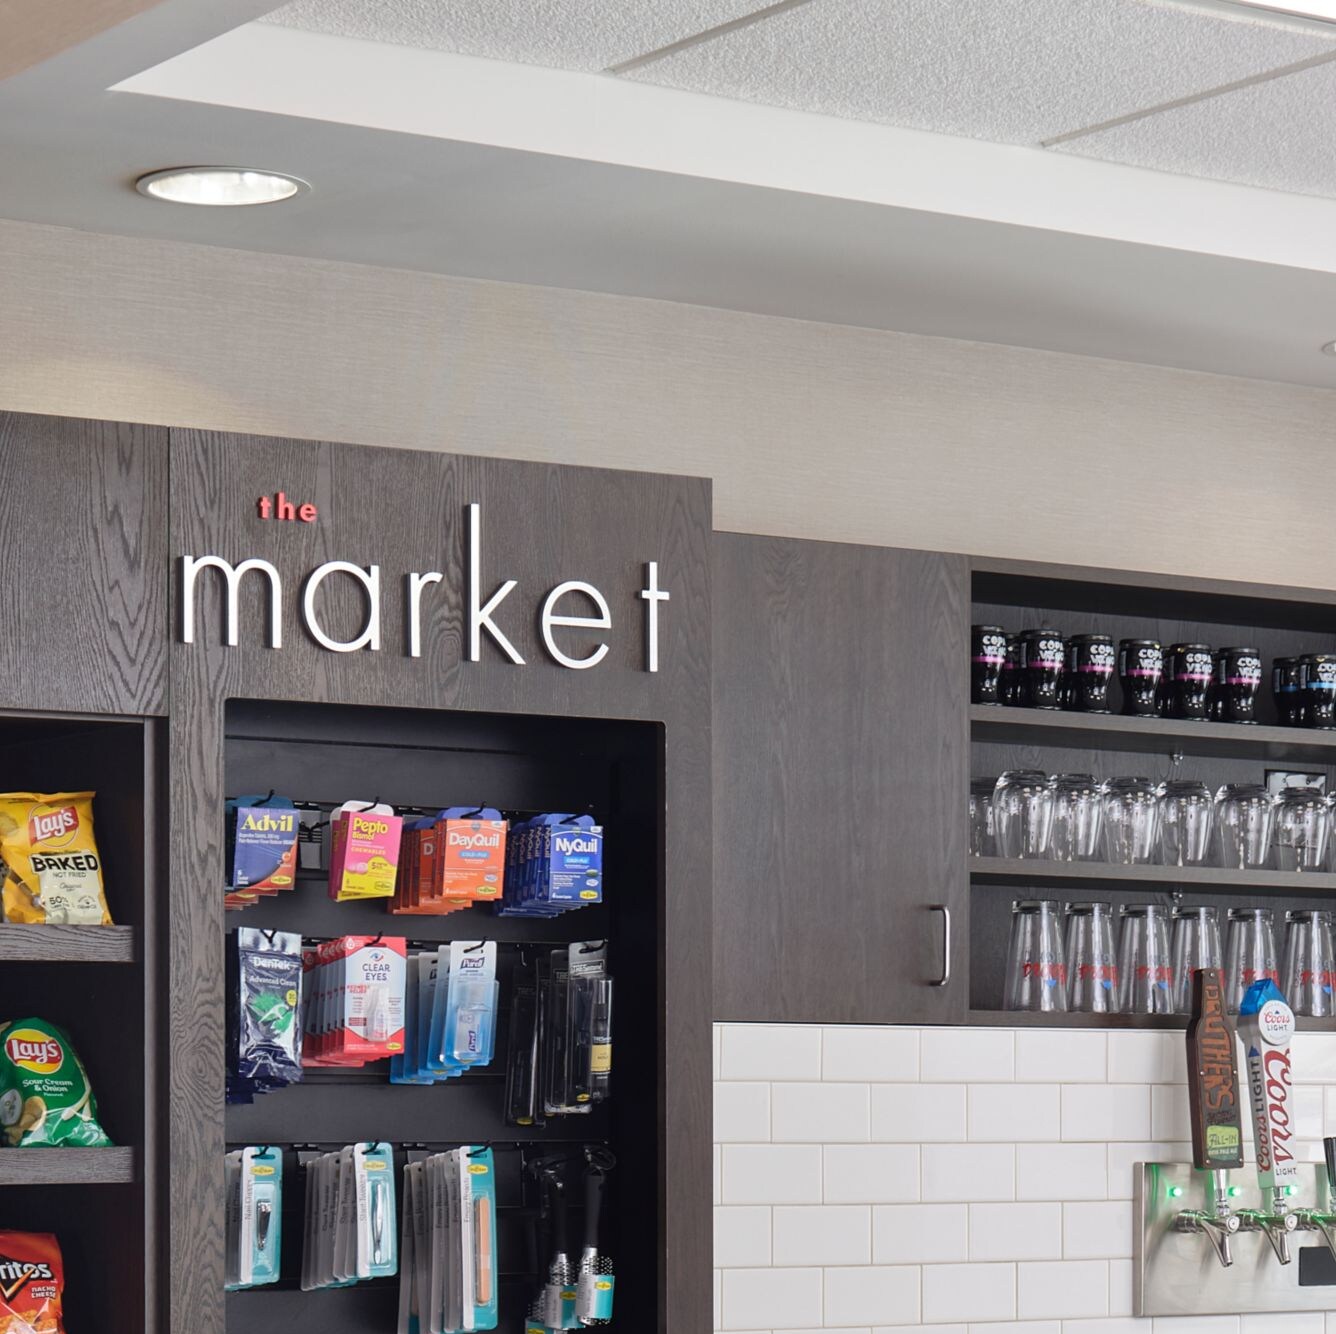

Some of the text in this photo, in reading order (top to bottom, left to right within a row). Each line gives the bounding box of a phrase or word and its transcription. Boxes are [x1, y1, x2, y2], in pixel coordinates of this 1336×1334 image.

[257, 491, 318, 522] the
[178, 503, 670, 673] market
[33, 810, 74, 841] Lay's
[241, 814, 293, 832] Advil
[353, 817, 389, 834] Pepto
[352, 831, 375, 840] Bismol
[449, 832, 500, 849] DayQuil
[556, 838, 598, 855] NyQuil
[31, 855, 99, 872] BAKED
[253, 956, 291, 970] DenTek
[362, 964, 391, 972] CLEAR
[250, 975, 297, 986] Advanced Clean
[365, 972, 388, 981] EYES
[1264, 1012, 1290, 1024] Coors
[11, 1039, 59, 1064] Lay's
[22, 1078, 73, 1087] Sour Cream
[1264, 1048, 1294, 1166] Coors
[1252, 1060, 1271, 1173] Coors LIGHT
[1275, 1167, 1297, 1176] LIGHT
